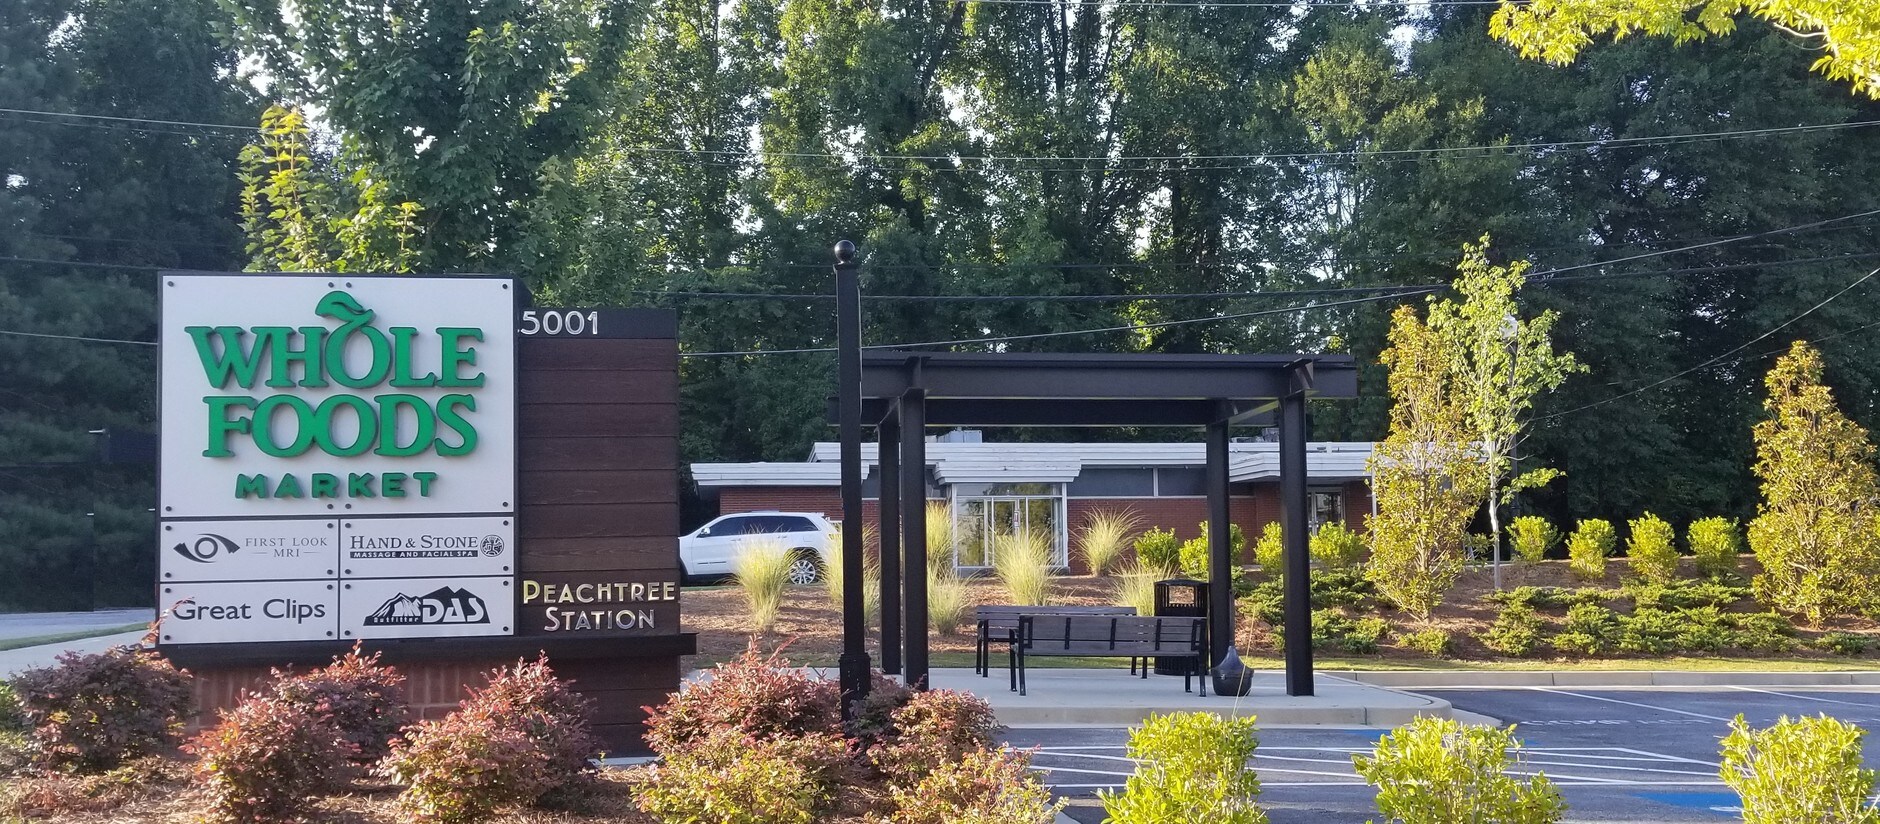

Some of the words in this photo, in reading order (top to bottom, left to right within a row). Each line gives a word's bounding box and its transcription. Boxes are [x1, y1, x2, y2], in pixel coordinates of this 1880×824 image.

[520, 310, 598, 335] 5001
[184, 316, 486, 390] WHOLE
[202, 393, 479, 458] FOODS
[234, 472, 438, 499] MARKET
[245, 537, 286, 547] FIRST
[292, 537, 328, 547] LOOK
[273, 548, 300, 558] MRI
[350, 535, 402, 549] HAND
[405, 538, 416, 549] &
[420, 534, 479, 549] STONE
[353, 551, 396, 559] MASSAGE
[523, 580, 676, 604] PEACHTREE
[173, 599, 252, 620] Great
[262, 598, 326, 625] Clips
[422, 597, 485, 623] DAS
[544, 606, 656, 632] STATION
